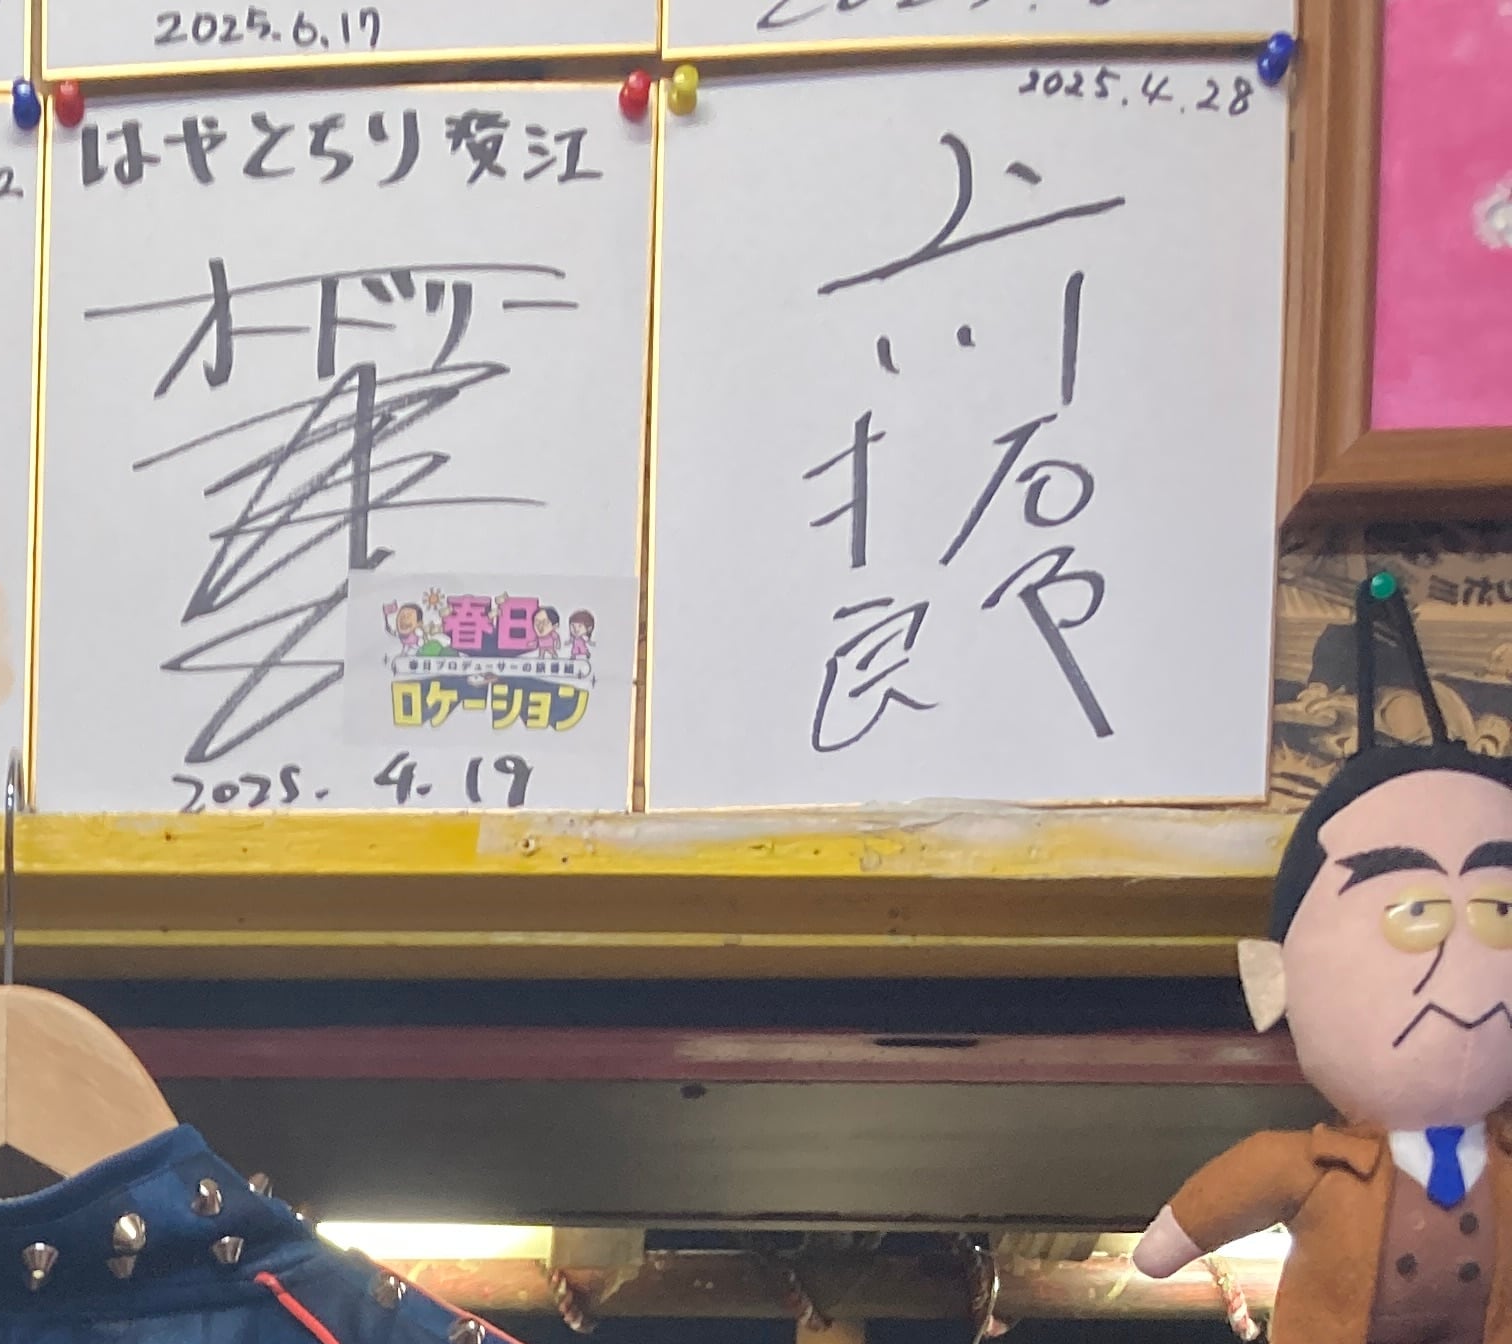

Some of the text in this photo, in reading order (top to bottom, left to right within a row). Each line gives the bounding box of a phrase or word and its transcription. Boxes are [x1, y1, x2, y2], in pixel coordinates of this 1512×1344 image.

[1019, 66, 1253, 116] 2025.4.28
[442, 594, 539, 650] 春日
[391, 681, 589, 731] ロケーション
